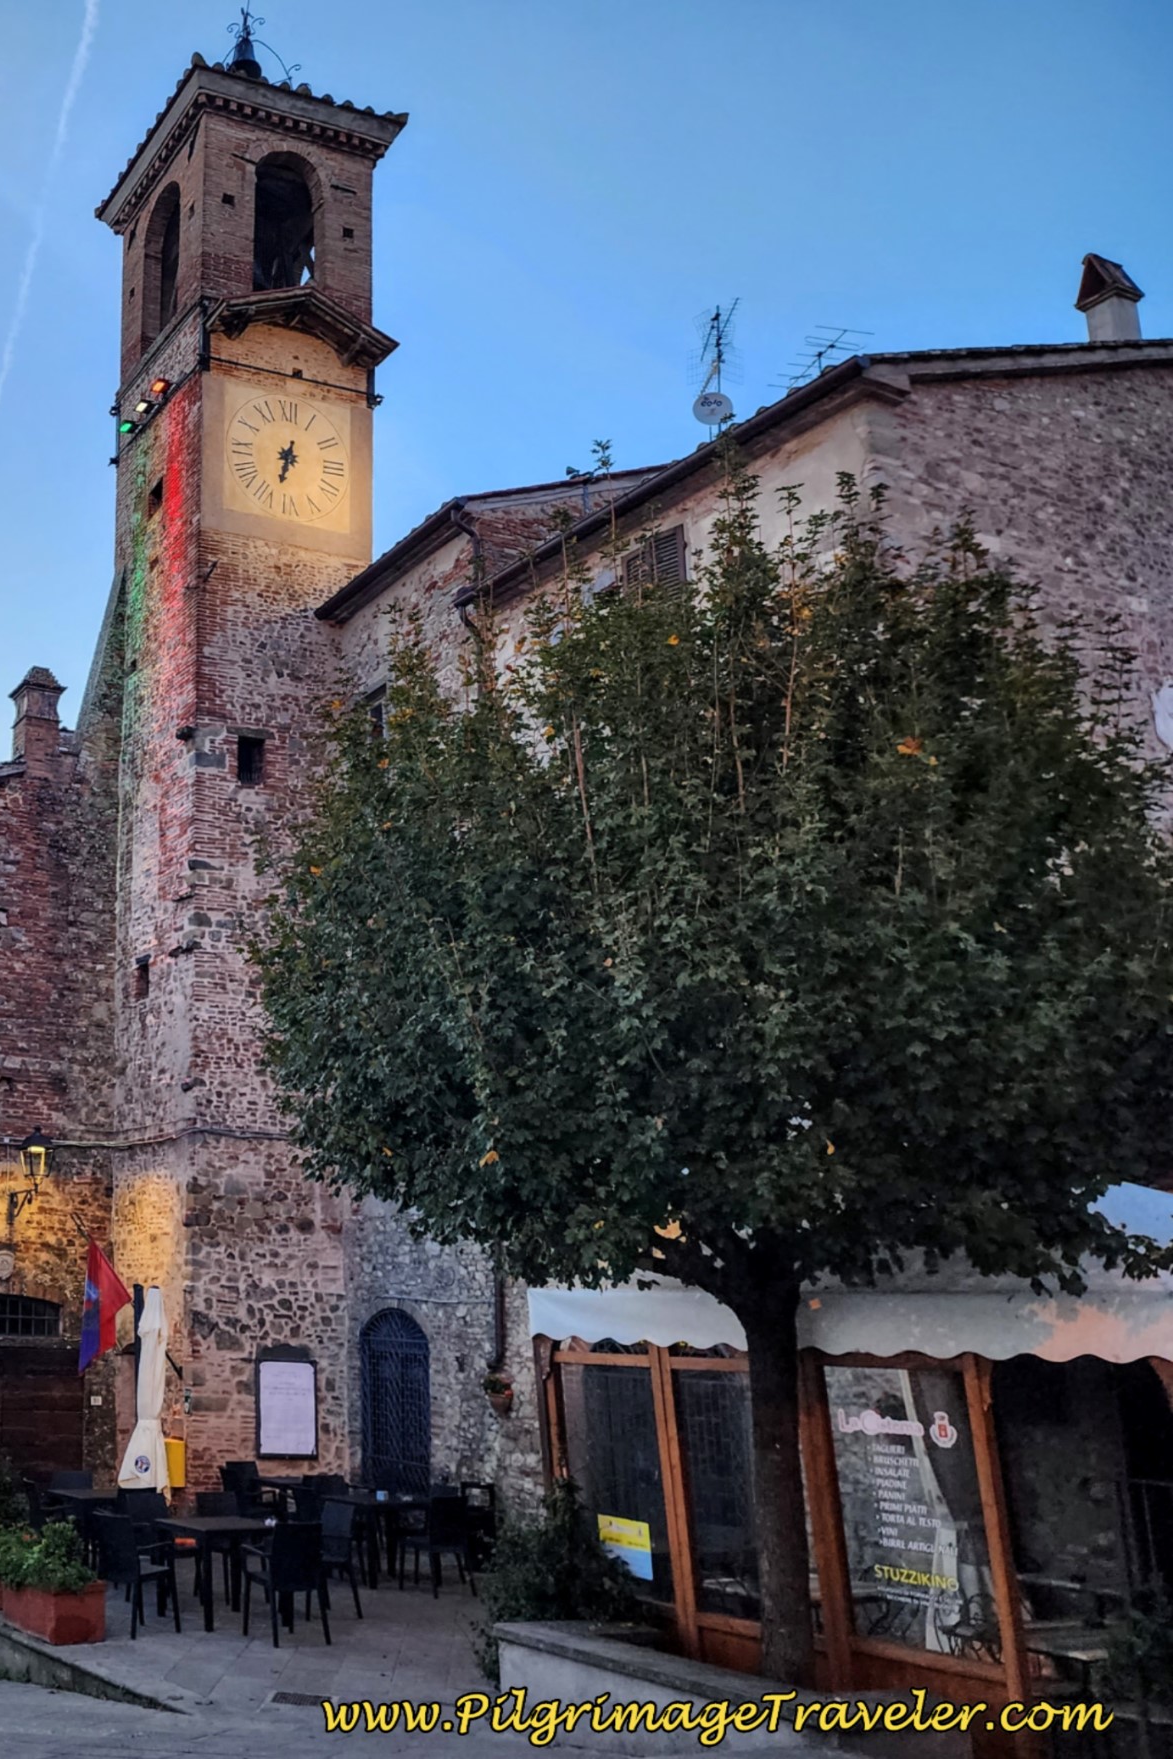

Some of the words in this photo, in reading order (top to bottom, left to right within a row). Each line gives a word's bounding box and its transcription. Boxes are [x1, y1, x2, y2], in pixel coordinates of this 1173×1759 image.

[253, 401, 275, 425] XI
[279, 400, 297, 425] XII
[238, 416, 260, 435] X
[305, 414, 316, 431] I
[232, 438, 253, 455] IX
[317, 437, 338, 450] II
[234, 462, 258, 488] VIII
[323, 460, 344, 477] III
[253, 480, 273, 509] VII
[318, 479, 339, 503] IV
[282, 494, 299, 517] VI
[307, 495, 321, 514] V
[881, 1513, 905, 1524] TORTA
[906, 1516, 916, 1526] AL
[919, 1517, 942, 1528] TESTO
[881, 1526, 898, 1536] VINI
[874, 1564, 959, 1591] STUZZIKINO
